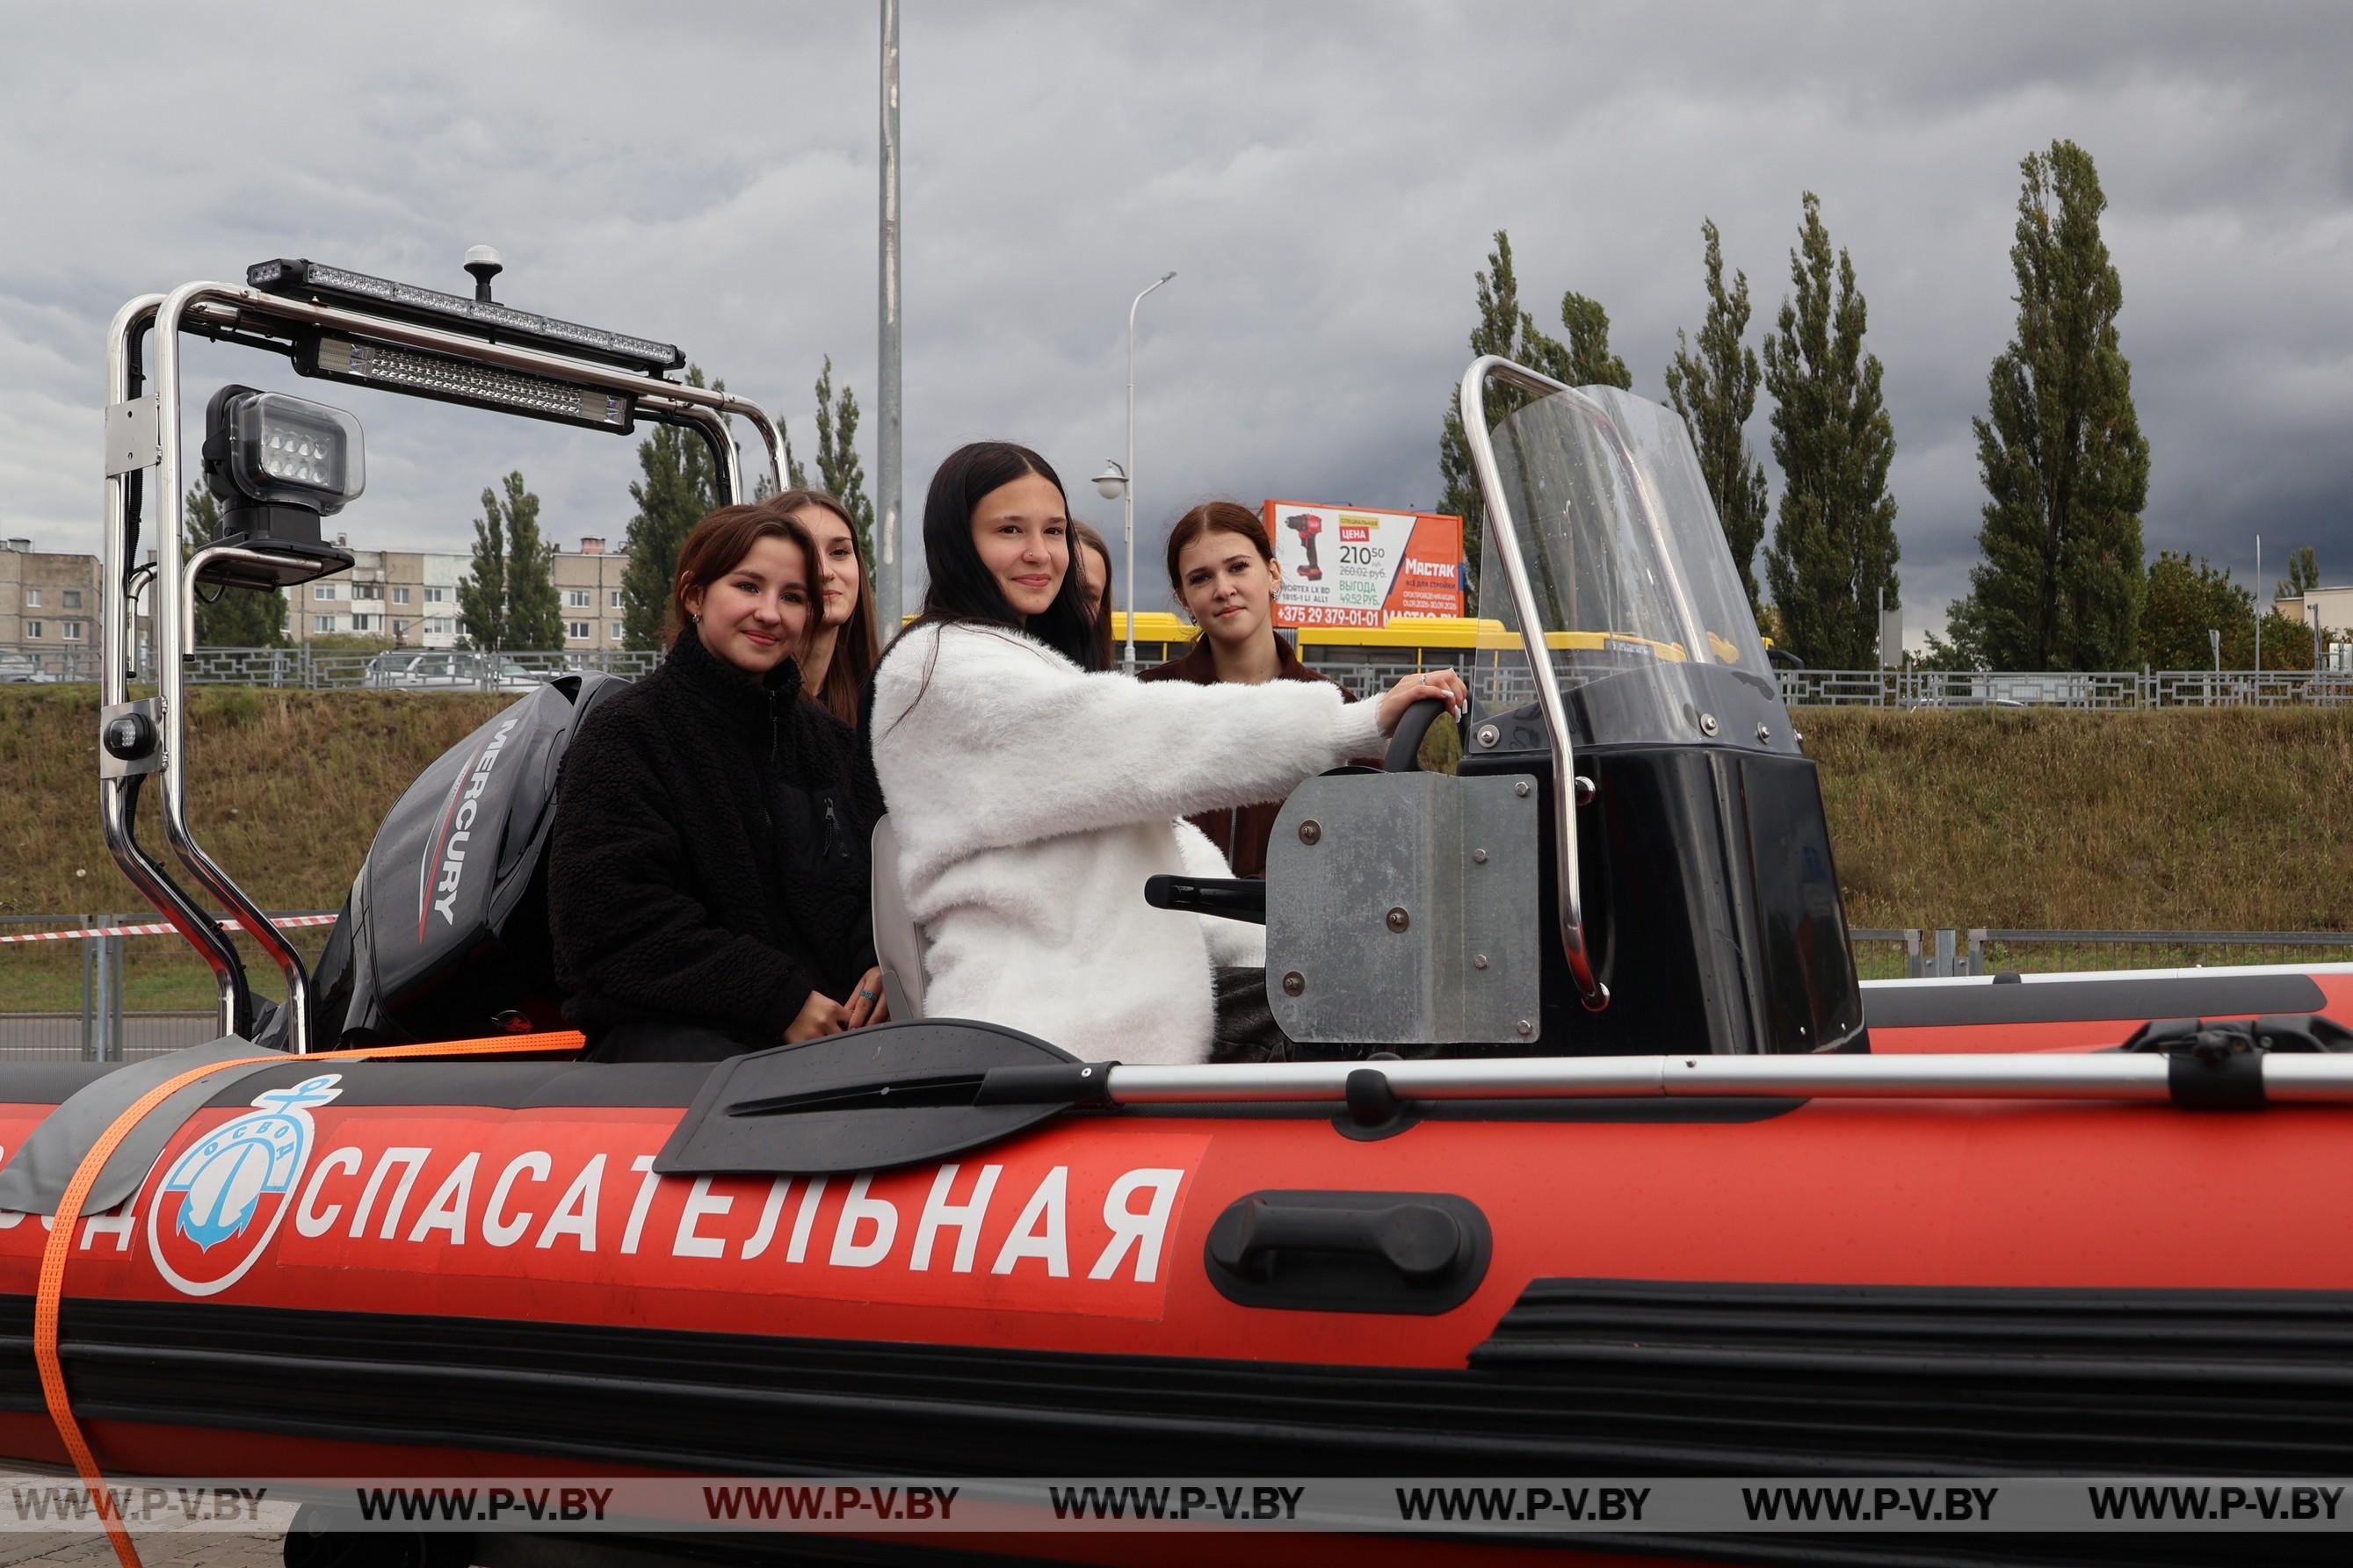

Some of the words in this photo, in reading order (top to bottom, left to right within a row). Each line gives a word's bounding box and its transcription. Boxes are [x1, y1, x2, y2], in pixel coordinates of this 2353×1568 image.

[1342, 529, 1367, 540] ЦЕНА
[1340, 546, 1372, 565] 210
[1372, 547, 1386, 559] 50
[1339, 580, 1377, 594] ВЫГОДА
[1340, 593, 1362, 605] 49.52
[1363, 595, 1380, 606] РУБ.
[1278, 605, 1307, 622] +375
[1308, 607, 1322, 623] 29
[1324, 609, 1379, 626] 379-01-01
[434, 718, 519, 927] MERCURY
[203, 1121, 296, 1161] ОСВОД
[295, 1145, 1186, 1283] СПАСАТЕЛЬНАЯ
